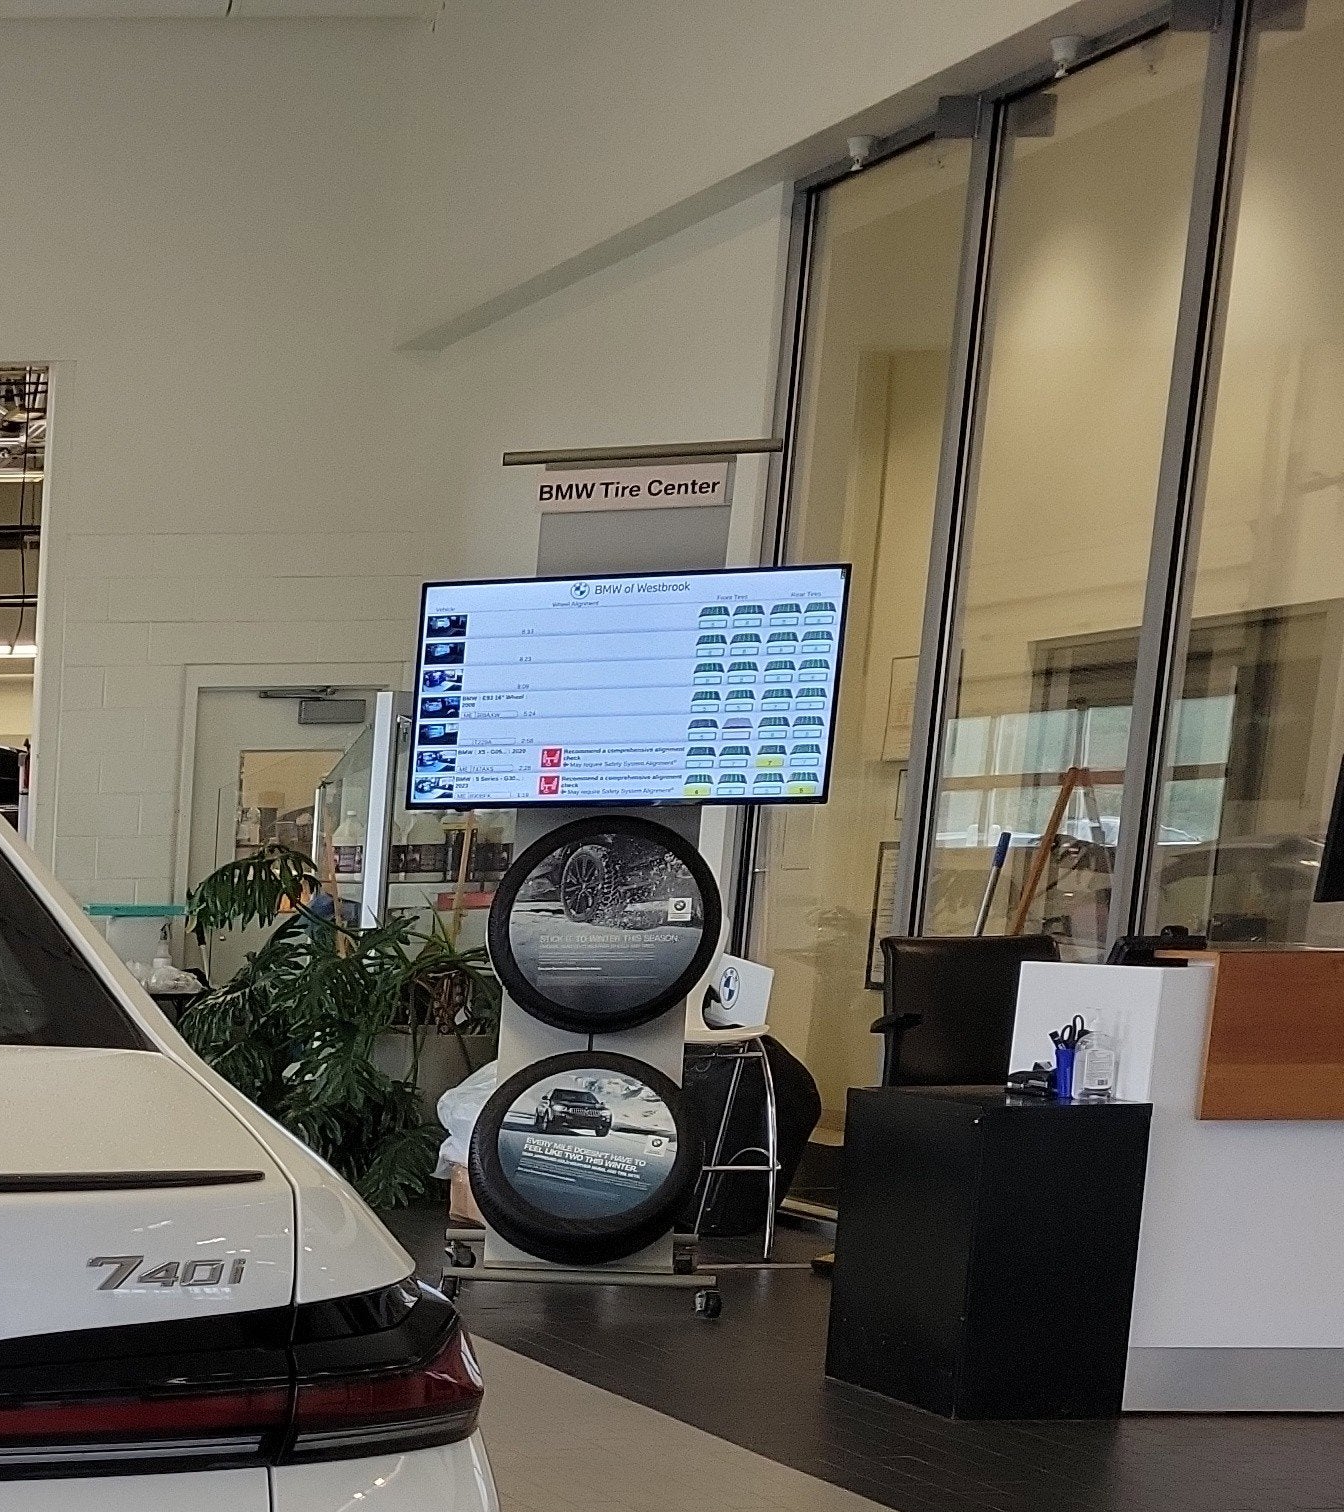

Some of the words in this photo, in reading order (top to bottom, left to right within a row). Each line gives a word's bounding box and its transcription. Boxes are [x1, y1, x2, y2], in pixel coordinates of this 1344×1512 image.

[539, 483, 596, 501] BMW
[599, 481, 641, 499] Tire
[647, 479, 721, 497] Center
[594, 583, 623, 595] BMW
[624, 583, 635, 594] of
[637, 581, 691, 593] Westbrook
[589, 935, 622, 943] WINTER
[523, 1144, 544, 1154] FEEL
[545, 1148, 563, 1157] LIKE
[564, 1152, 584, 1161] TWO
[585, 1155, 605, 1166] THIS
[526, 1136, 553, 1148] EVERY
[553, 1142, 573, 1152] MILE
[610, 1154, 634, 1164] HAVE
[634, 1159, 647, 1167] TO
[85, 1255, 247, 1291] 740i
